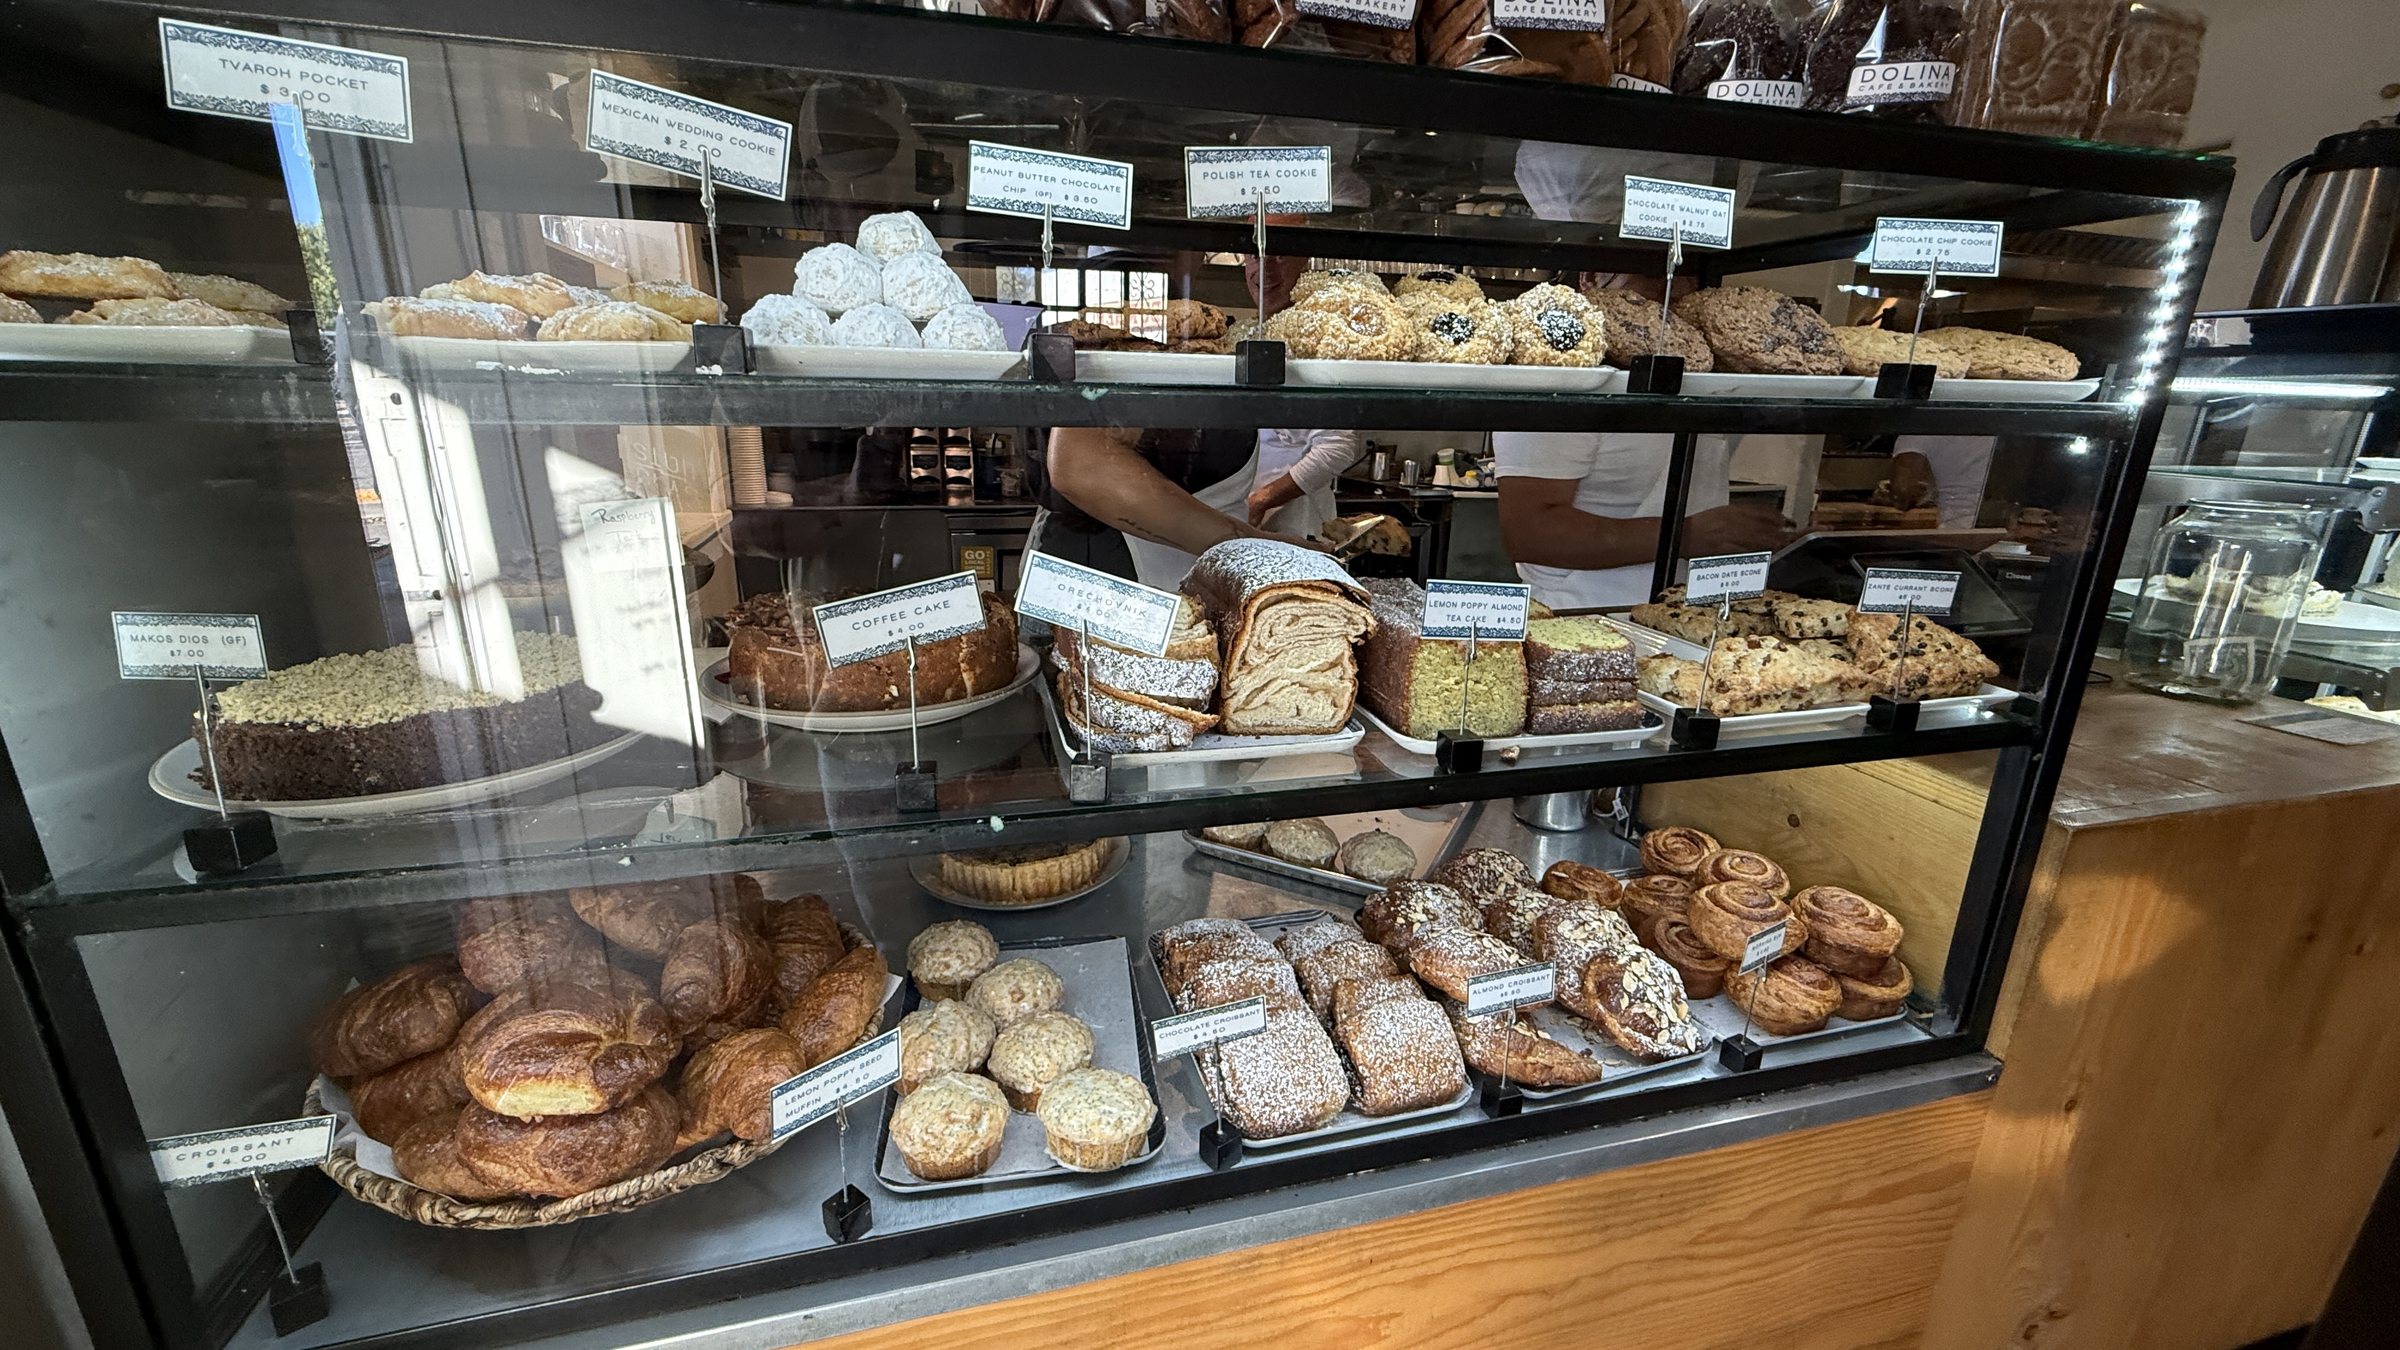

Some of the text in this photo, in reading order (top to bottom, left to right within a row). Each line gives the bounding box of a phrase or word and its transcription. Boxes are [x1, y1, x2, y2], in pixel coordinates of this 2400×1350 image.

[1504, 5, 1535, 13] CAFE
[1551, 8, 1597, 17] BAKERY
[219, 58, 369, 91] TVAROH POCKET
[1861, 64, 1950, 83] DOLINA
[1716, 83, 1796, 98] DOLINA
[1858, 83, 1892, 92] CAFE
[602, 102, 776, 156] MEXICAN WEDDING COOKIE
[974, 166, 1121, 193] PEANUT BUTTER CHOCOLATE
[1202, 169, 1317, 180] POLISH TEA COOKIE
[1002, 186, 1026, 194] CHIP
[1627, 199, 1727, 218] CHOCOLATE WALNUT OAT
[1639, 214, 1668, 223] COOKIE
[1881, 235, 1934, 244] CHOCOLATE
[590, 508, 656, 524] Raspberry
[964, 550, 985, 560] GO
[1697, 572, 1719, 581] BACON
[852, 600, 951, 631] COFFEE CAKE
[130, 634, 247, 646] MAKOS DIOS (GF)
[1473, 974, 1550, 995] ALMOND CROISSANT
[1159, 1009, 1260, 1039] CHOCOLATE CROISSANT
[784, 1054, 882, 1106] LEMON POPPY SEED
[785, 1097, 822, 1118] MUFFIN
[176, 1137, 294, 1161] CROISSANT
